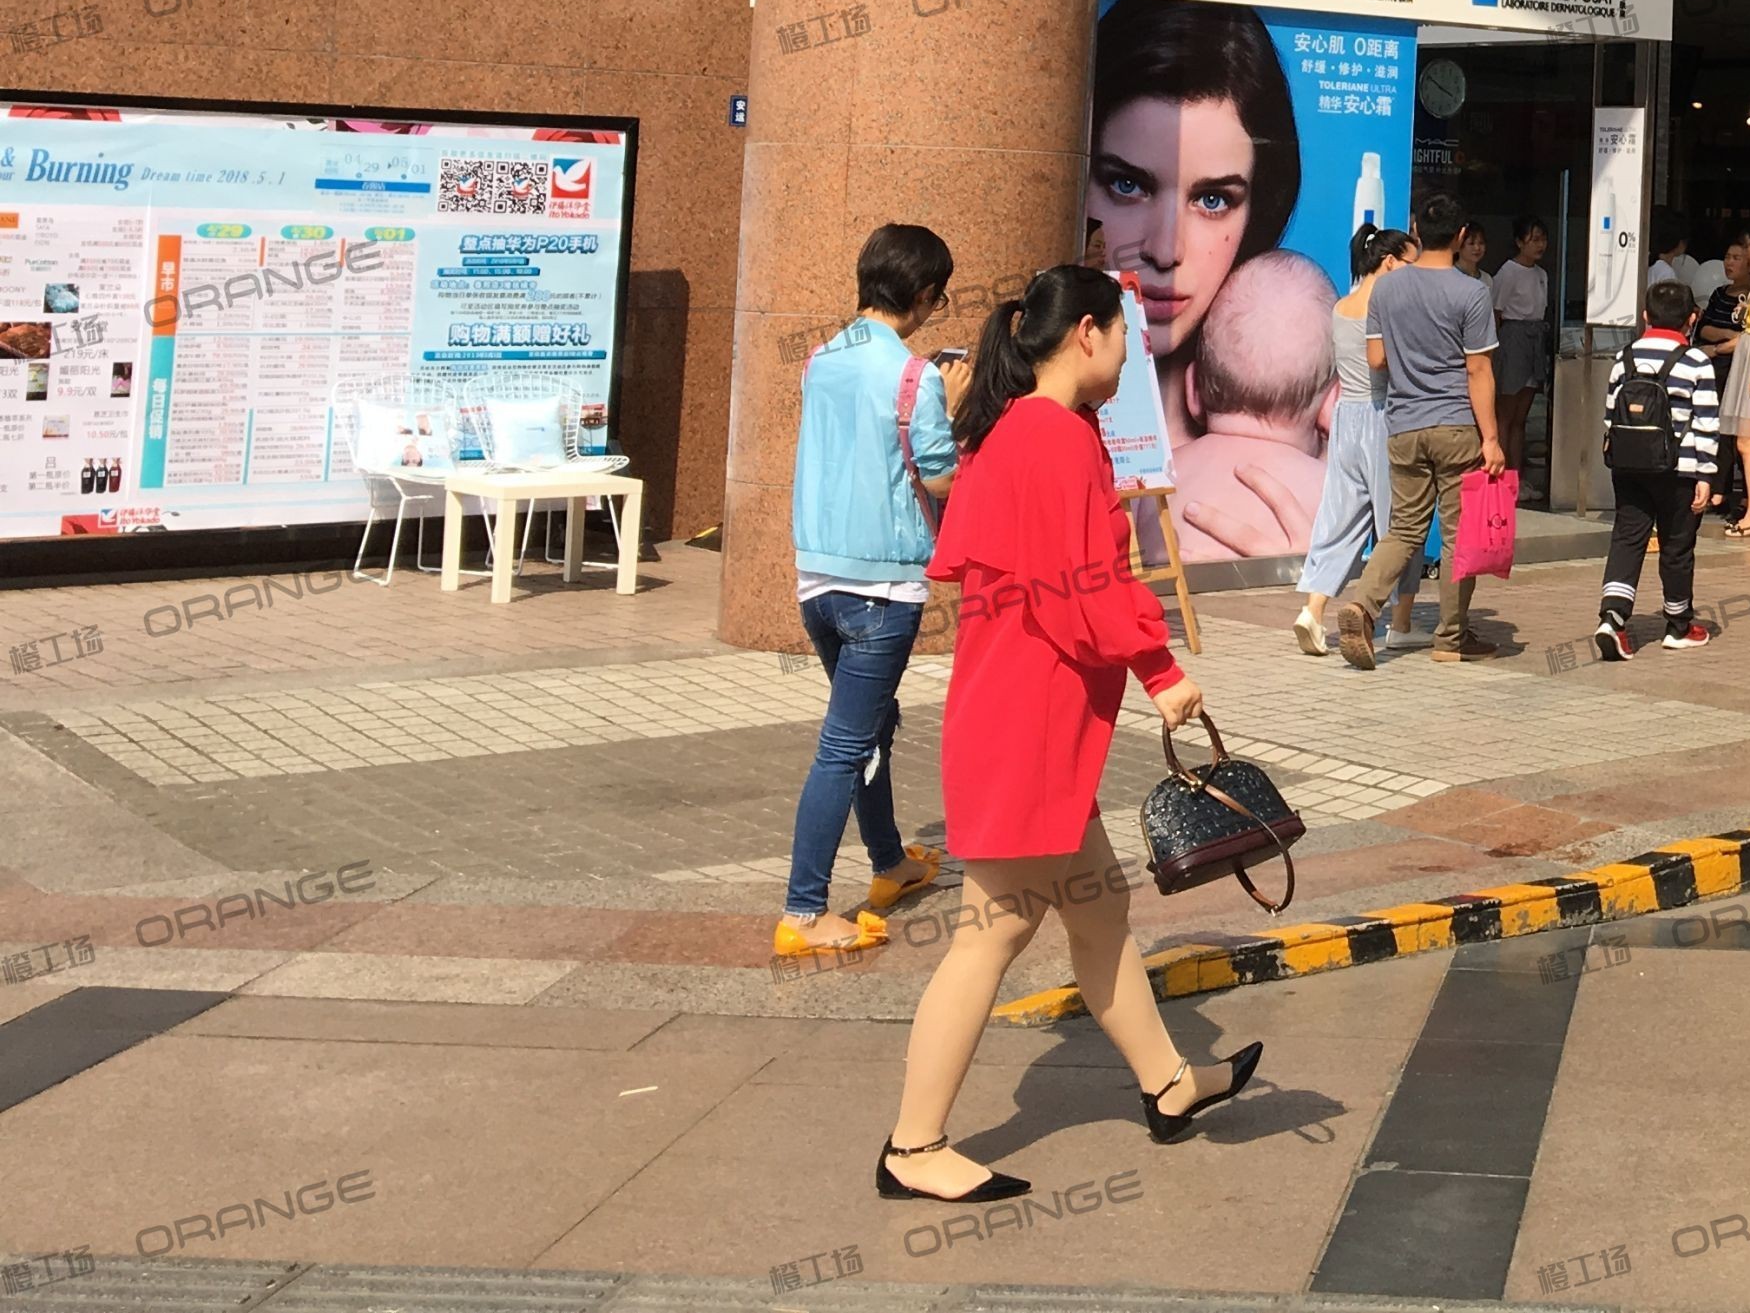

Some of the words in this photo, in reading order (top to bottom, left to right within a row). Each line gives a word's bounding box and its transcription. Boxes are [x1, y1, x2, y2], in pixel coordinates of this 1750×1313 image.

[1551, 4, 1615, 17] DERMATOLOGIQUE
[1294, 32, 1346, 55] 安心肌
[1354, 37, 1399, 60] 0距离
[1319, 80, 1369, 93] TOLERIANE
[1370, 82, 1397, 94] ULTRA
[25, 148, 134, 190] Burning
[140, 167, 181, 182] Dream
[185, 168, 213, 183] time
[460, 235, 598, 254] 整点抽华为P20手机
[161, 261, 176, 292] 早市
[448, 324, 591, 346] 购物满额赠好礼
